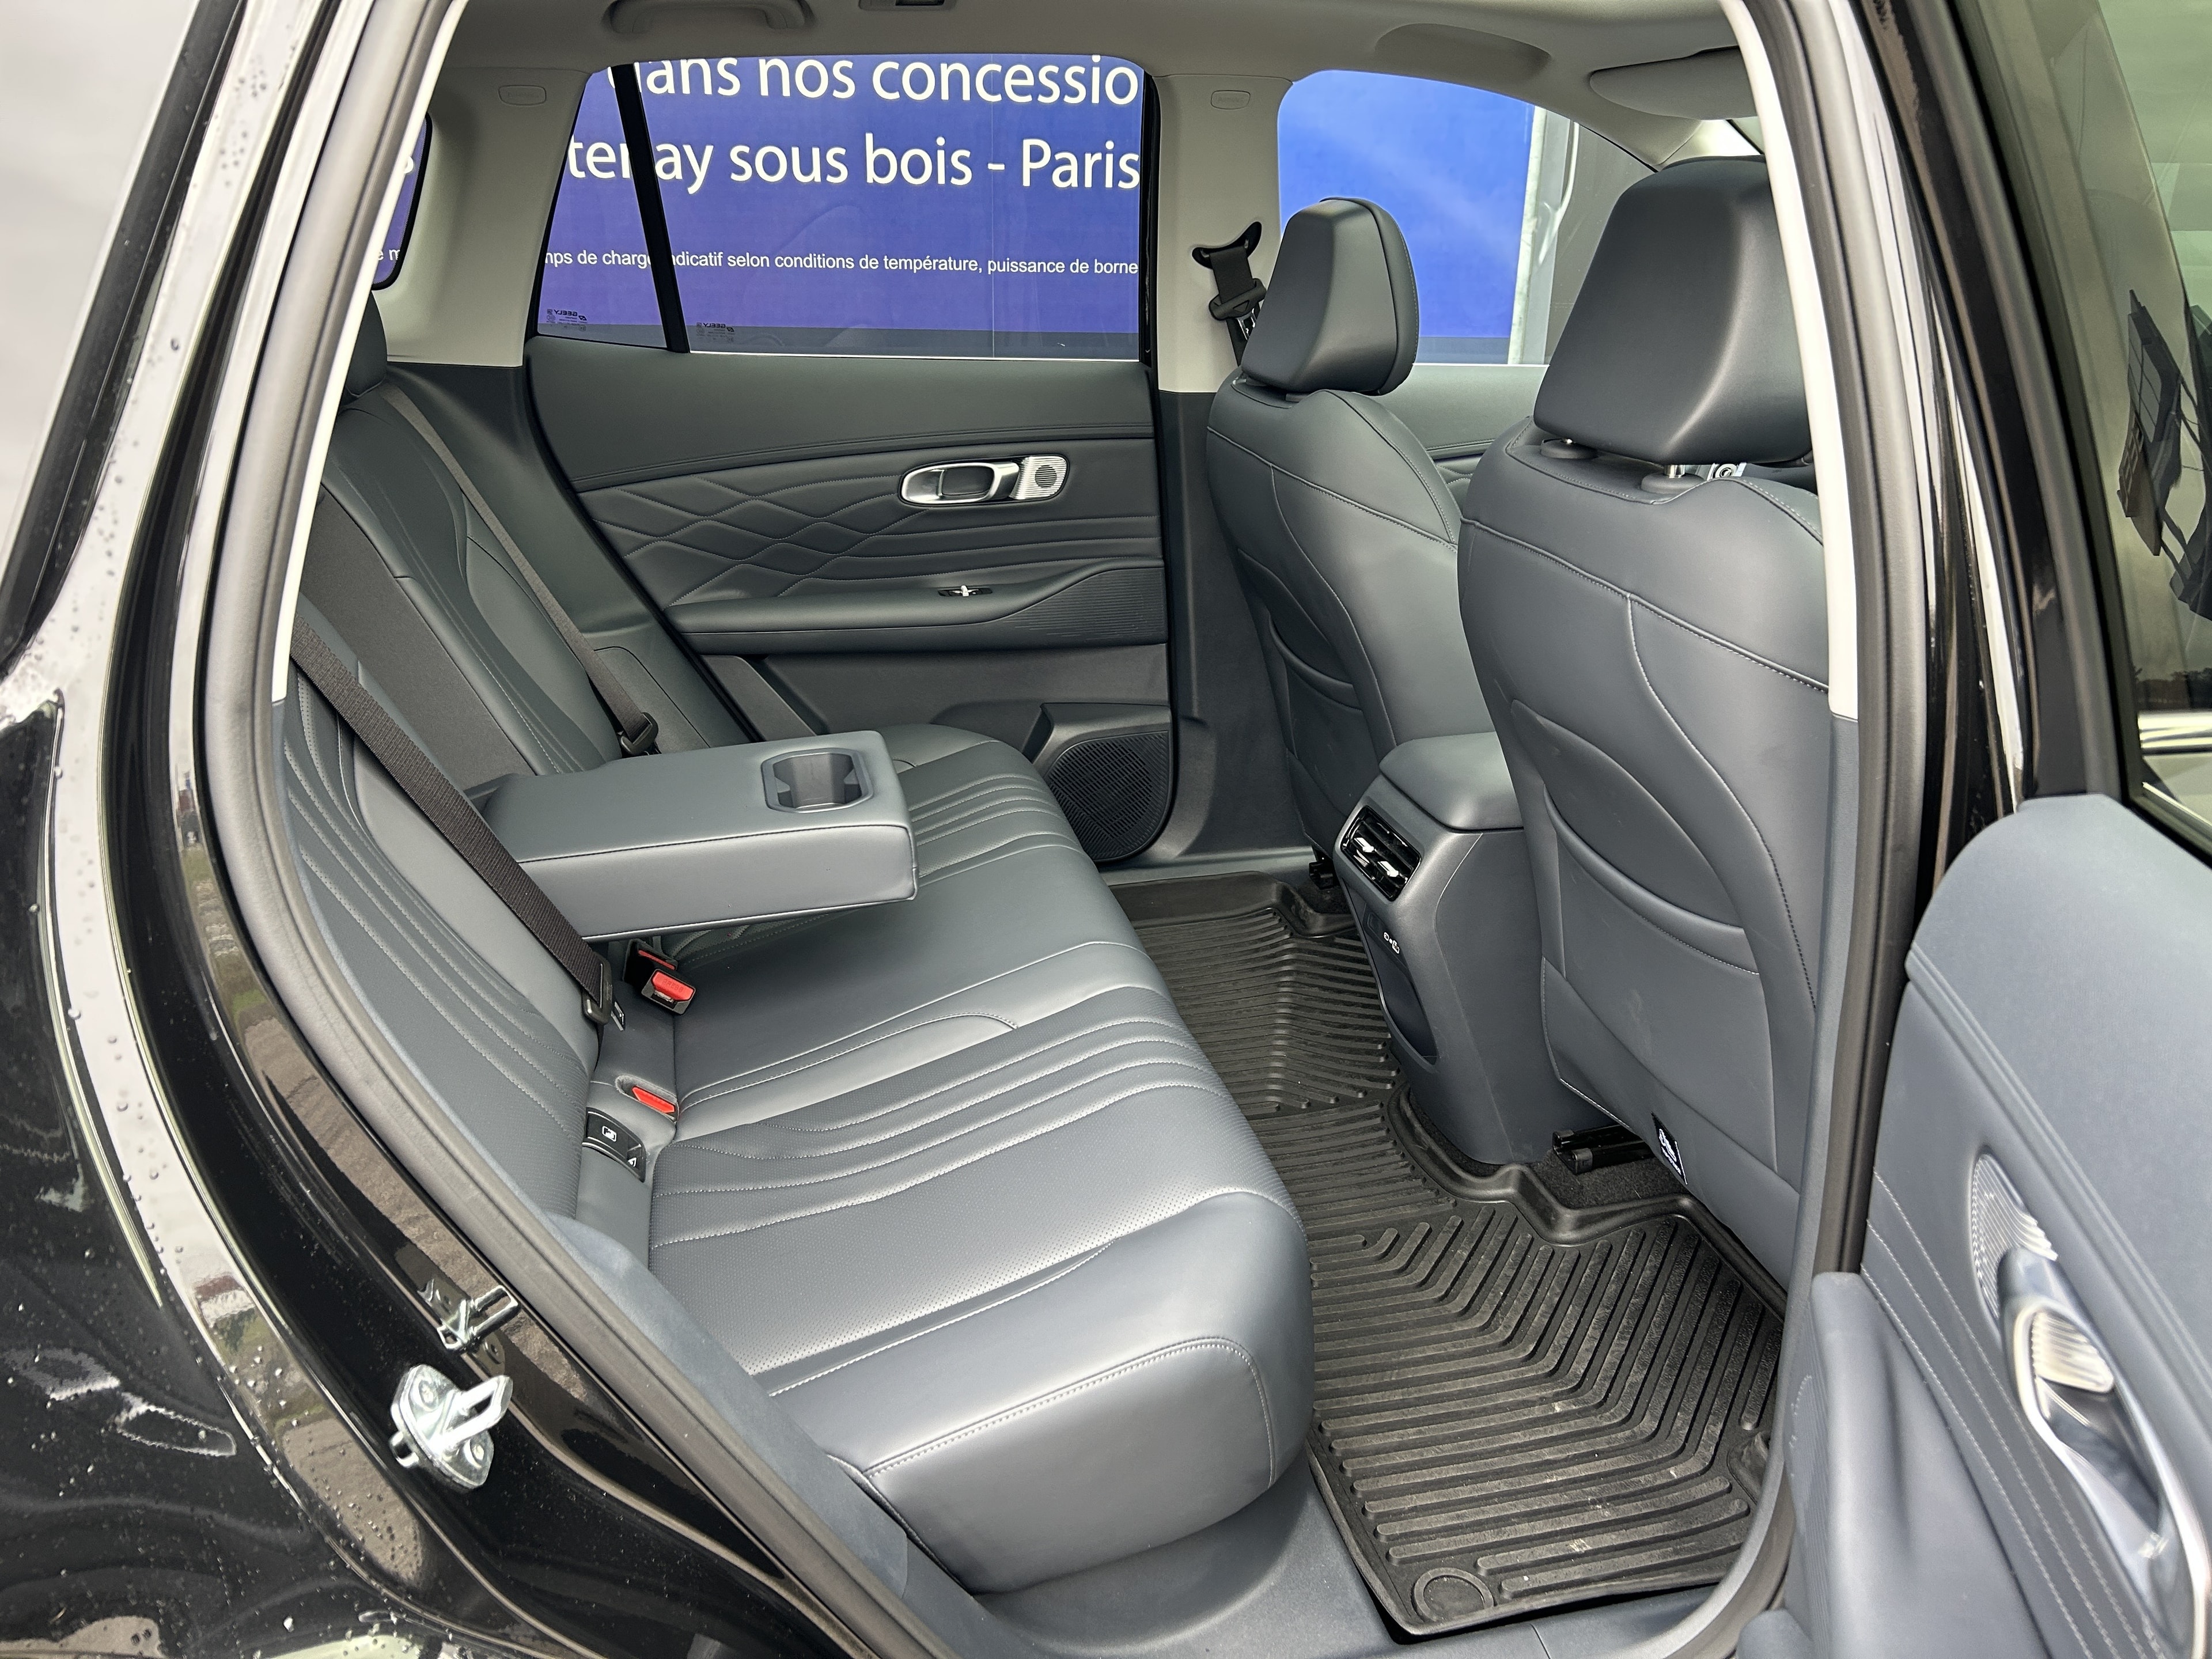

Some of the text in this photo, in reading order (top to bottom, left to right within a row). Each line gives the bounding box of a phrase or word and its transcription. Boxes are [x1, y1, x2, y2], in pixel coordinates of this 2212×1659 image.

[758, 56, 856, 100] nos
[872, 54, 1138, 105] concessio
[729, 144, 849, 183] sous
[865, 132, 972, 185] bois
[1022, 138, 1139, 189] Paris
[577, 249, 598, 264] de
[672, 251, 724, 267] dicatif
[727, 252, 770, 267] selon
[774, 253, 855, 269] conditions
[859, 254, 879, 269] de
[883, 255, 982, 274] température,
[987, 257, 1065, 275] puissance
[1070, 259, 1089, 274] de
[1094, 259, 1139, 274] borne
